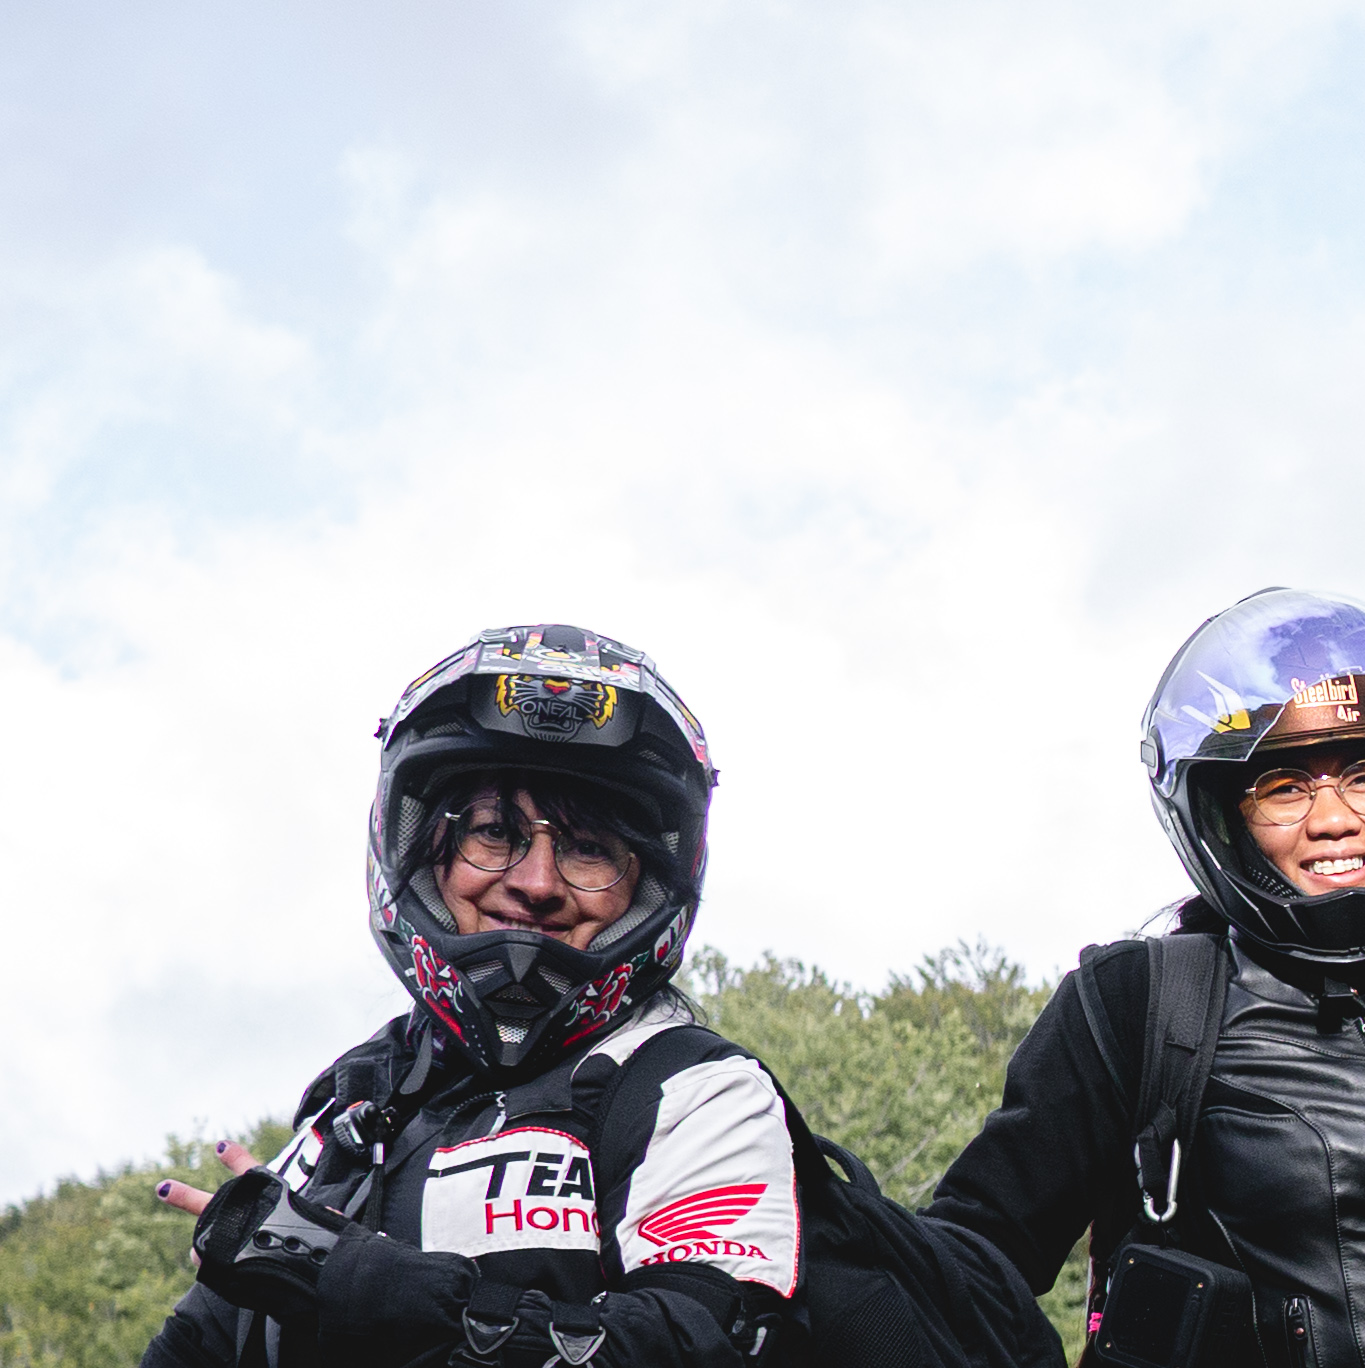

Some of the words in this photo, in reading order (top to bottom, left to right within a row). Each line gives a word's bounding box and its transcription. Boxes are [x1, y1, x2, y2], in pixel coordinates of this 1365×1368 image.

[1290, 671, 1359, 709] Steelbird
[520, 700, 584, 721] ONEAL
[1336, 705, 1361, 723] Air
[436, 1150, 594, 1201] TEA
[484, 1198, 600, 1235] Hon
